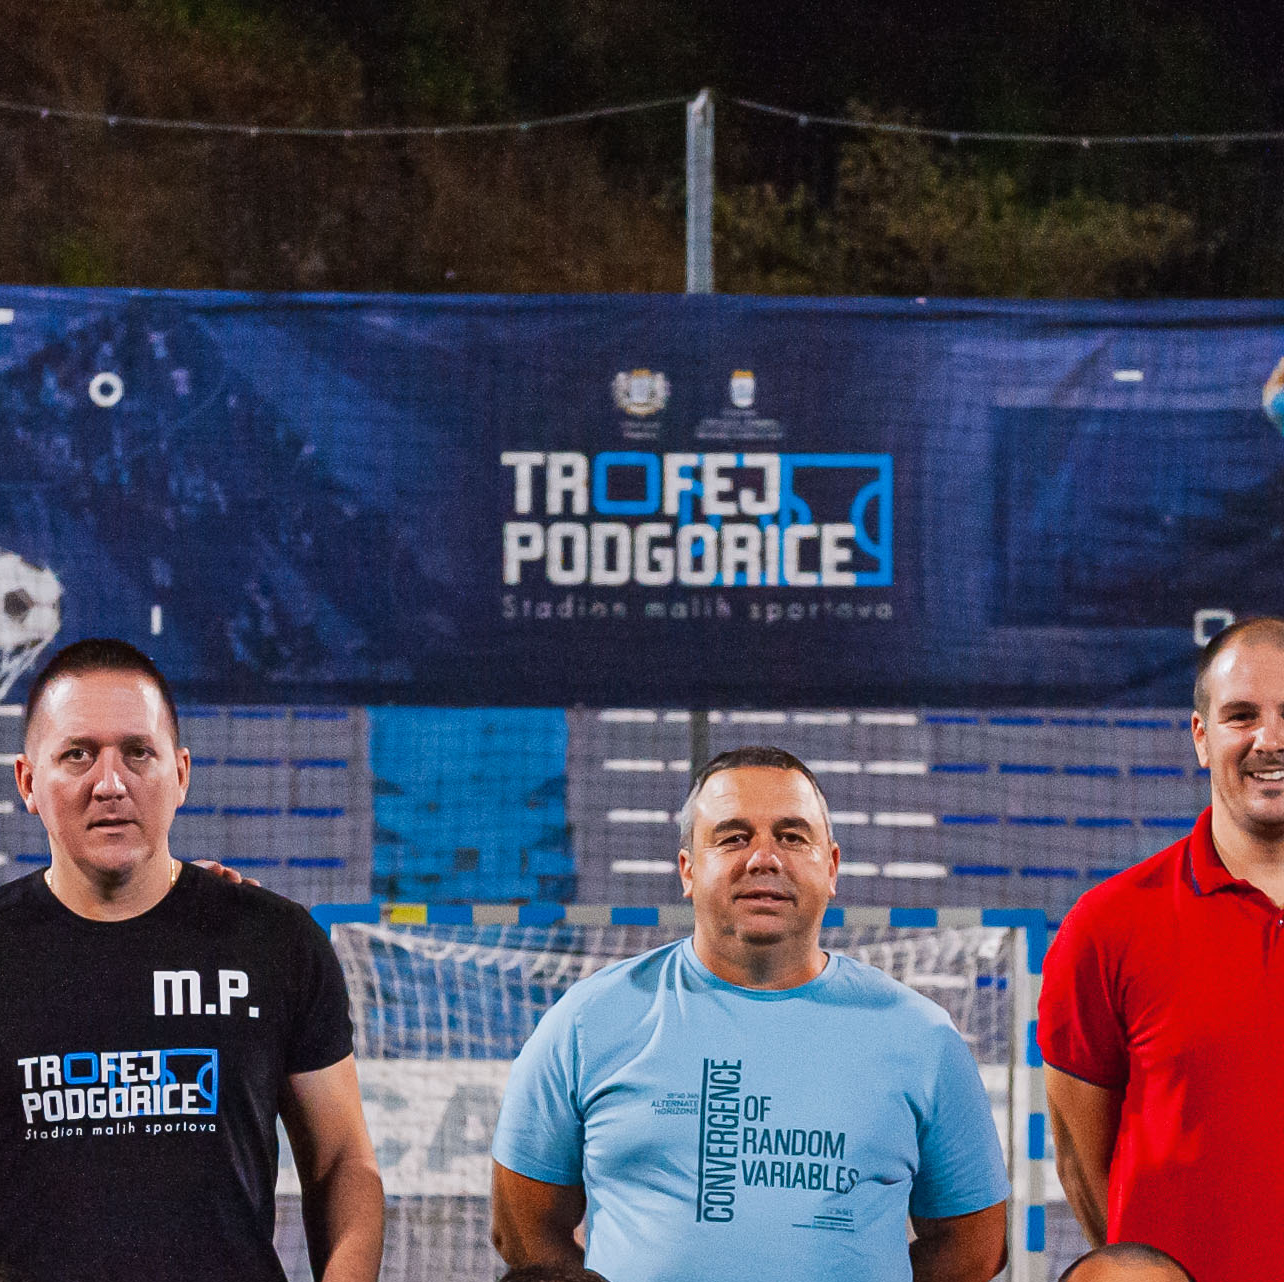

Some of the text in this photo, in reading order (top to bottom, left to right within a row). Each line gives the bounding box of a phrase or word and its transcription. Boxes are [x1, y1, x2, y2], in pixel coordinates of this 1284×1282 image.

[500, 451, 782, 516] TROFEJ
[502, 522, 857, 586] PODGORICE
[501, 596, 894, 623] Stadion malih sportova
[153, 970, 260, 1018] M.P.
[17, 1050, 161, 1089] TROFEJ
[22, 1083, 200, 1124] PODGORICE
[743, 1095, 772, 1122] OF
[25, 1121, 216, 1140] Stadion malih sportova
[703, 1059, 742, 1223] CONVERGENCE
[743, 1127, 846, 1160] RANDOM
[741, 1160, 860, 1195] VARIABLES
